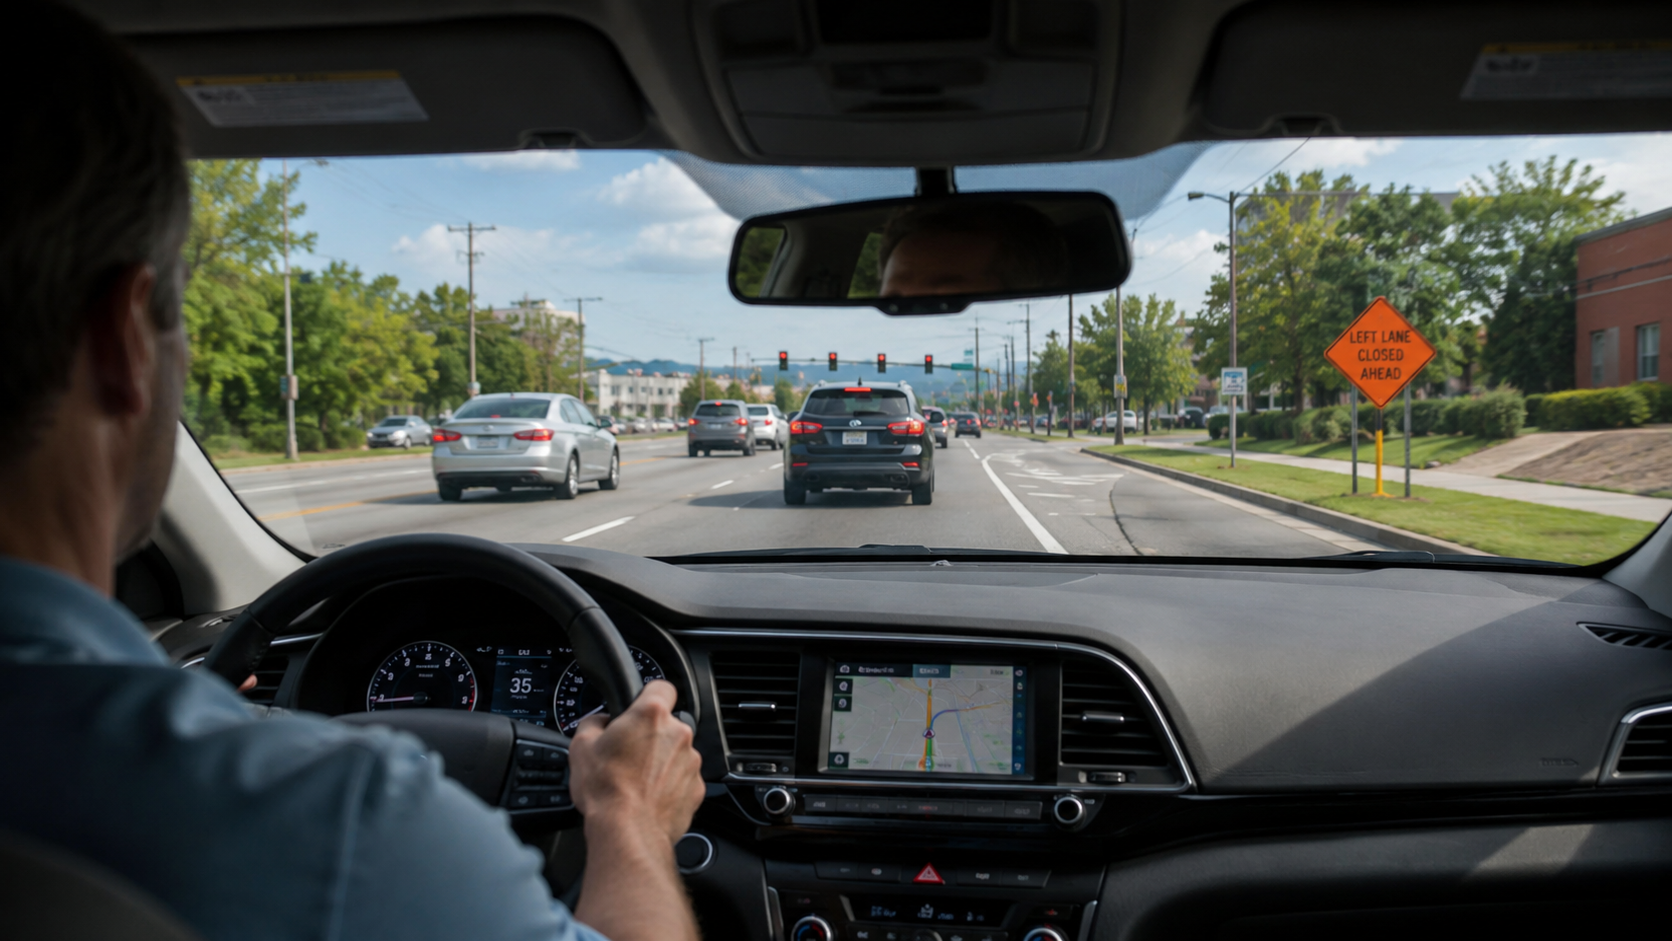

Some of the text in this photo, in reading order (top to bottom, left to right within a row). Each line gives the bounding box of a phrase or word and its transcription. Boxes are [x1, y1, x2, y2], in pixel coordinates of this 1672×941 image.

[1350, 330, 1411, 343] LEFT LANE
[1358, 349, 1404, 361] CLOSED
[1361, 368, 1401, 380] AHEAD
[509, 677, 532, 694] 35
